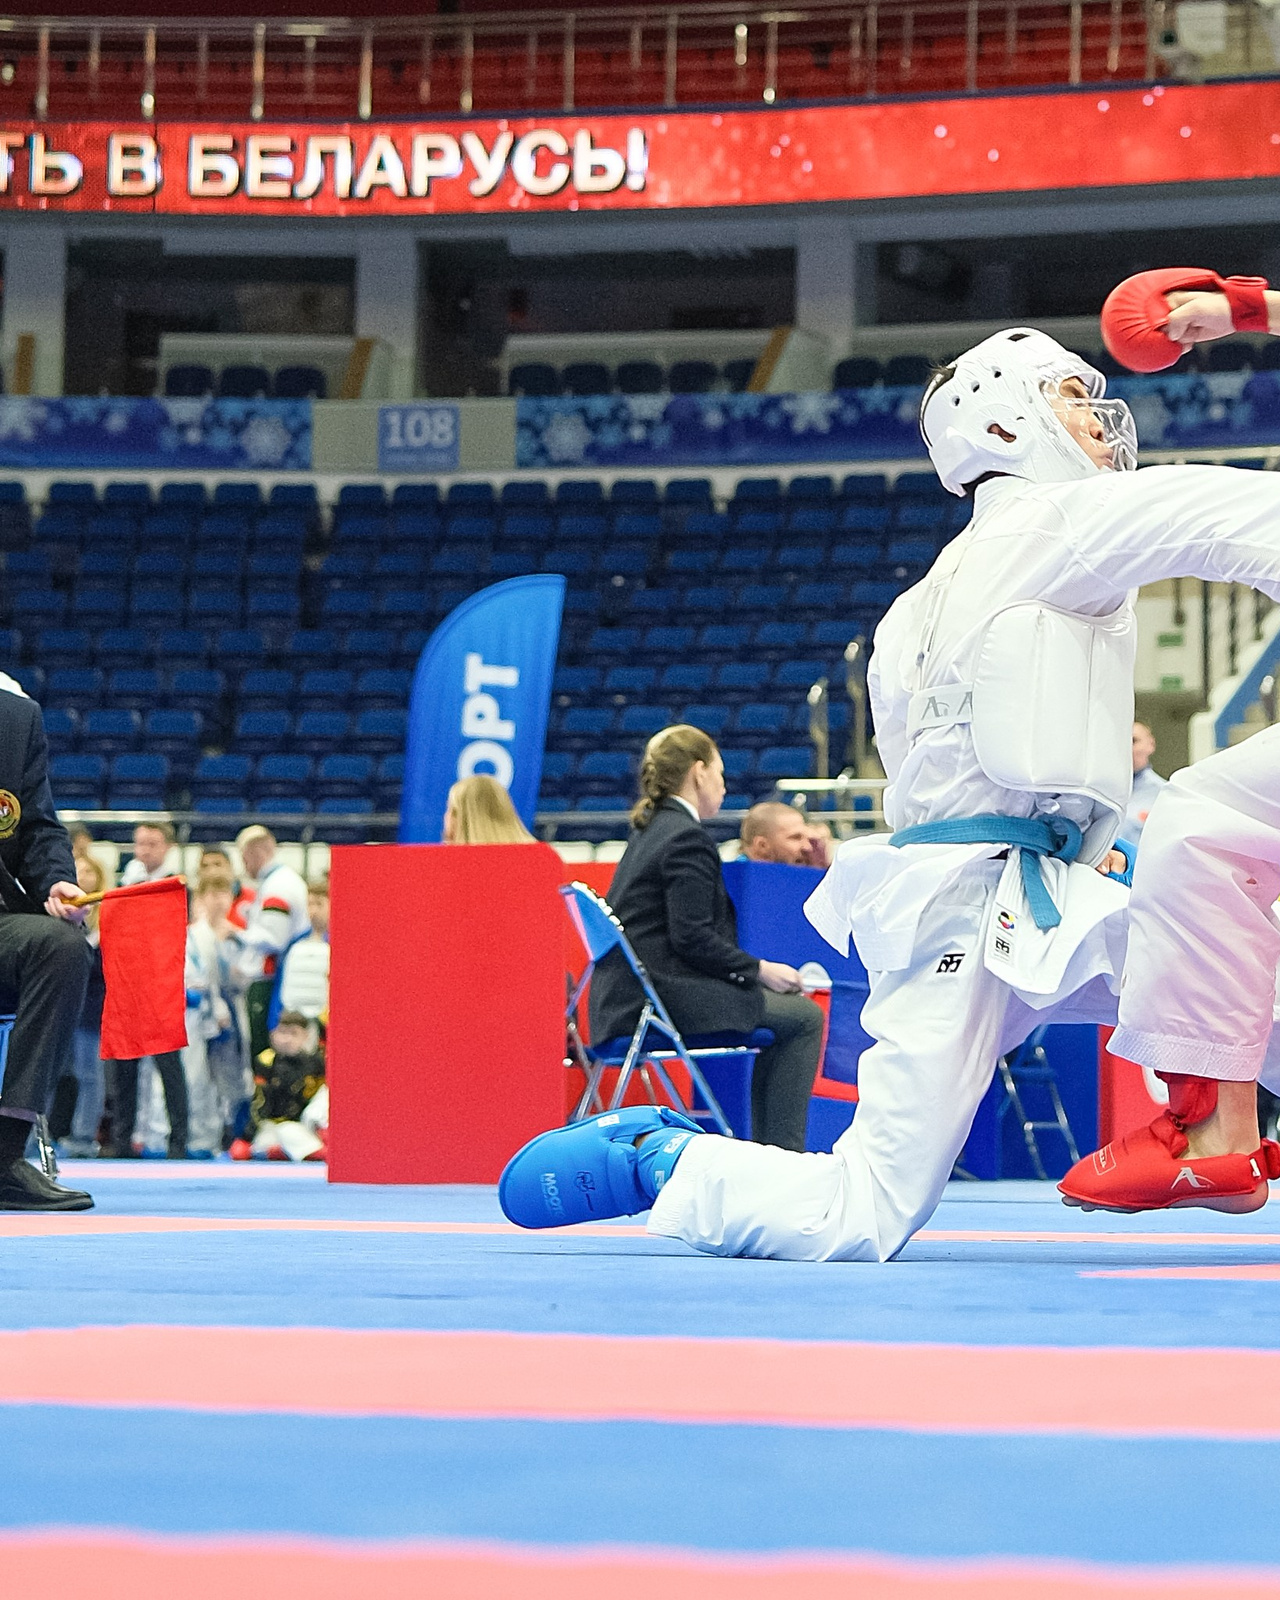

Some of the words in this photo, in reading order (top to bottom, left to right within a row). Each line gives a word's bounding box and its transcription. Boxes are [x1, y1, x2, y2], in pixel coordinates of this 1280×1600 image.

[107, 132, 161, 196] В
[187, 127, 649, 199] БЕЛАРУСЬ!
[385, 410, 454, 449] 108
[456, 652, 520, 792] ОРТ
